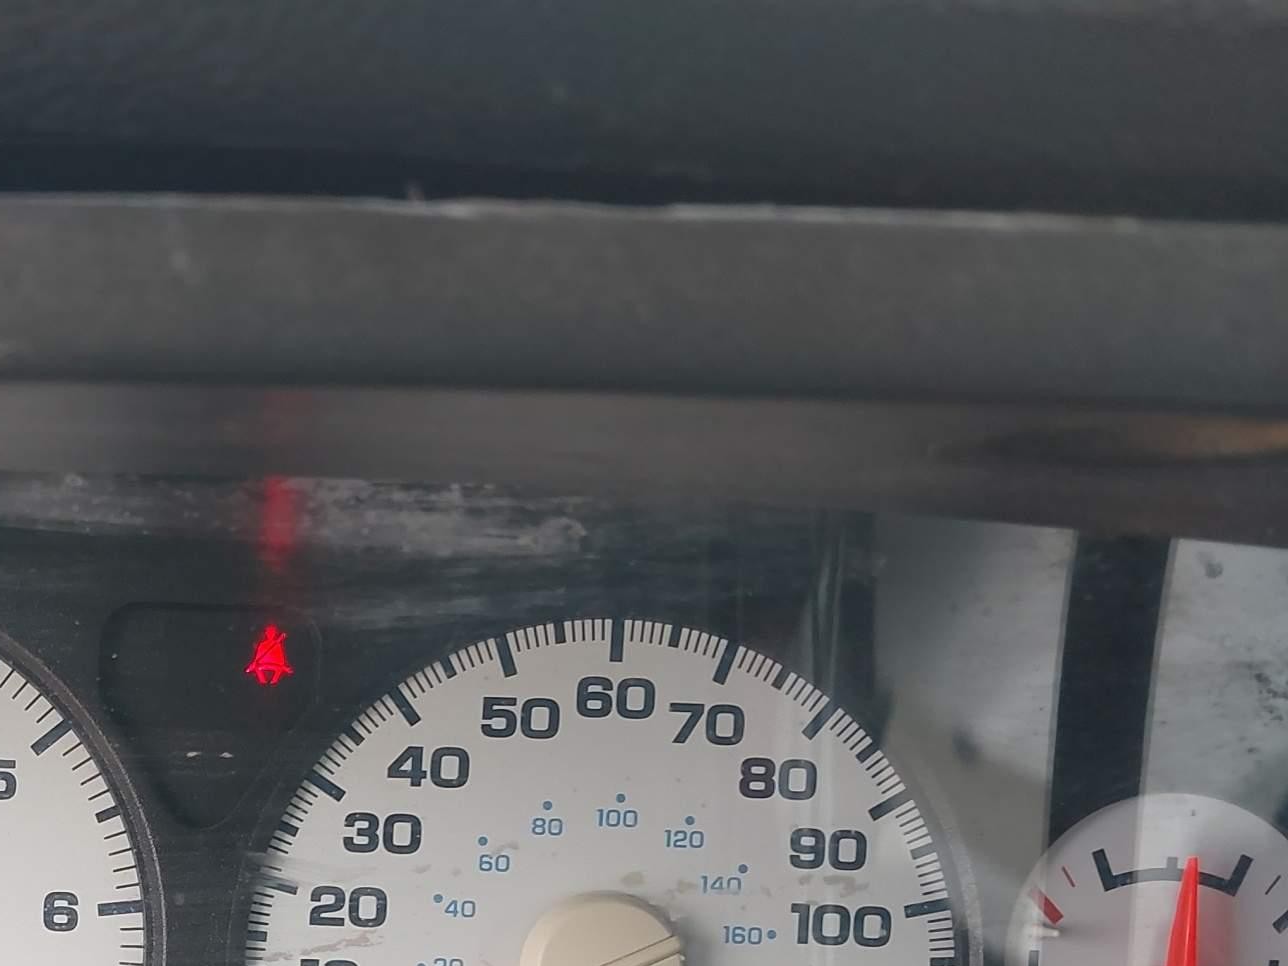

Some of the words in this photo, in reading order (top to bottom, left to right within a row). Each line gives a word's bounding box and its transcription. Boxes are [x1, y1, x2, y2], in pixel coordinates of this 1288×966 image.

[481, 697, 560, 739] 50
[577, 677, 655, 719] 60
[669, 703, 745, 745] 70
[387, 746, 469, 788] 40
[739, 758, 817, 800] 80
[343, 812, 421, 854] 30
[532, 818, 563, 835] 80
[597, 809, 637, 827] 100
[665, 830, 704, 848] 120
[790, 828, 867, 870] 90
[479, 855, 509, 872] 60
[701, 876, 741, 893] 140
[43, 892, 78, 932] 6
[309, 886, 387, 927] 20
[445, 900, 475, 917] 40
[791, 903, 891, 947] 100
[723, 926, 762, 944] 160
